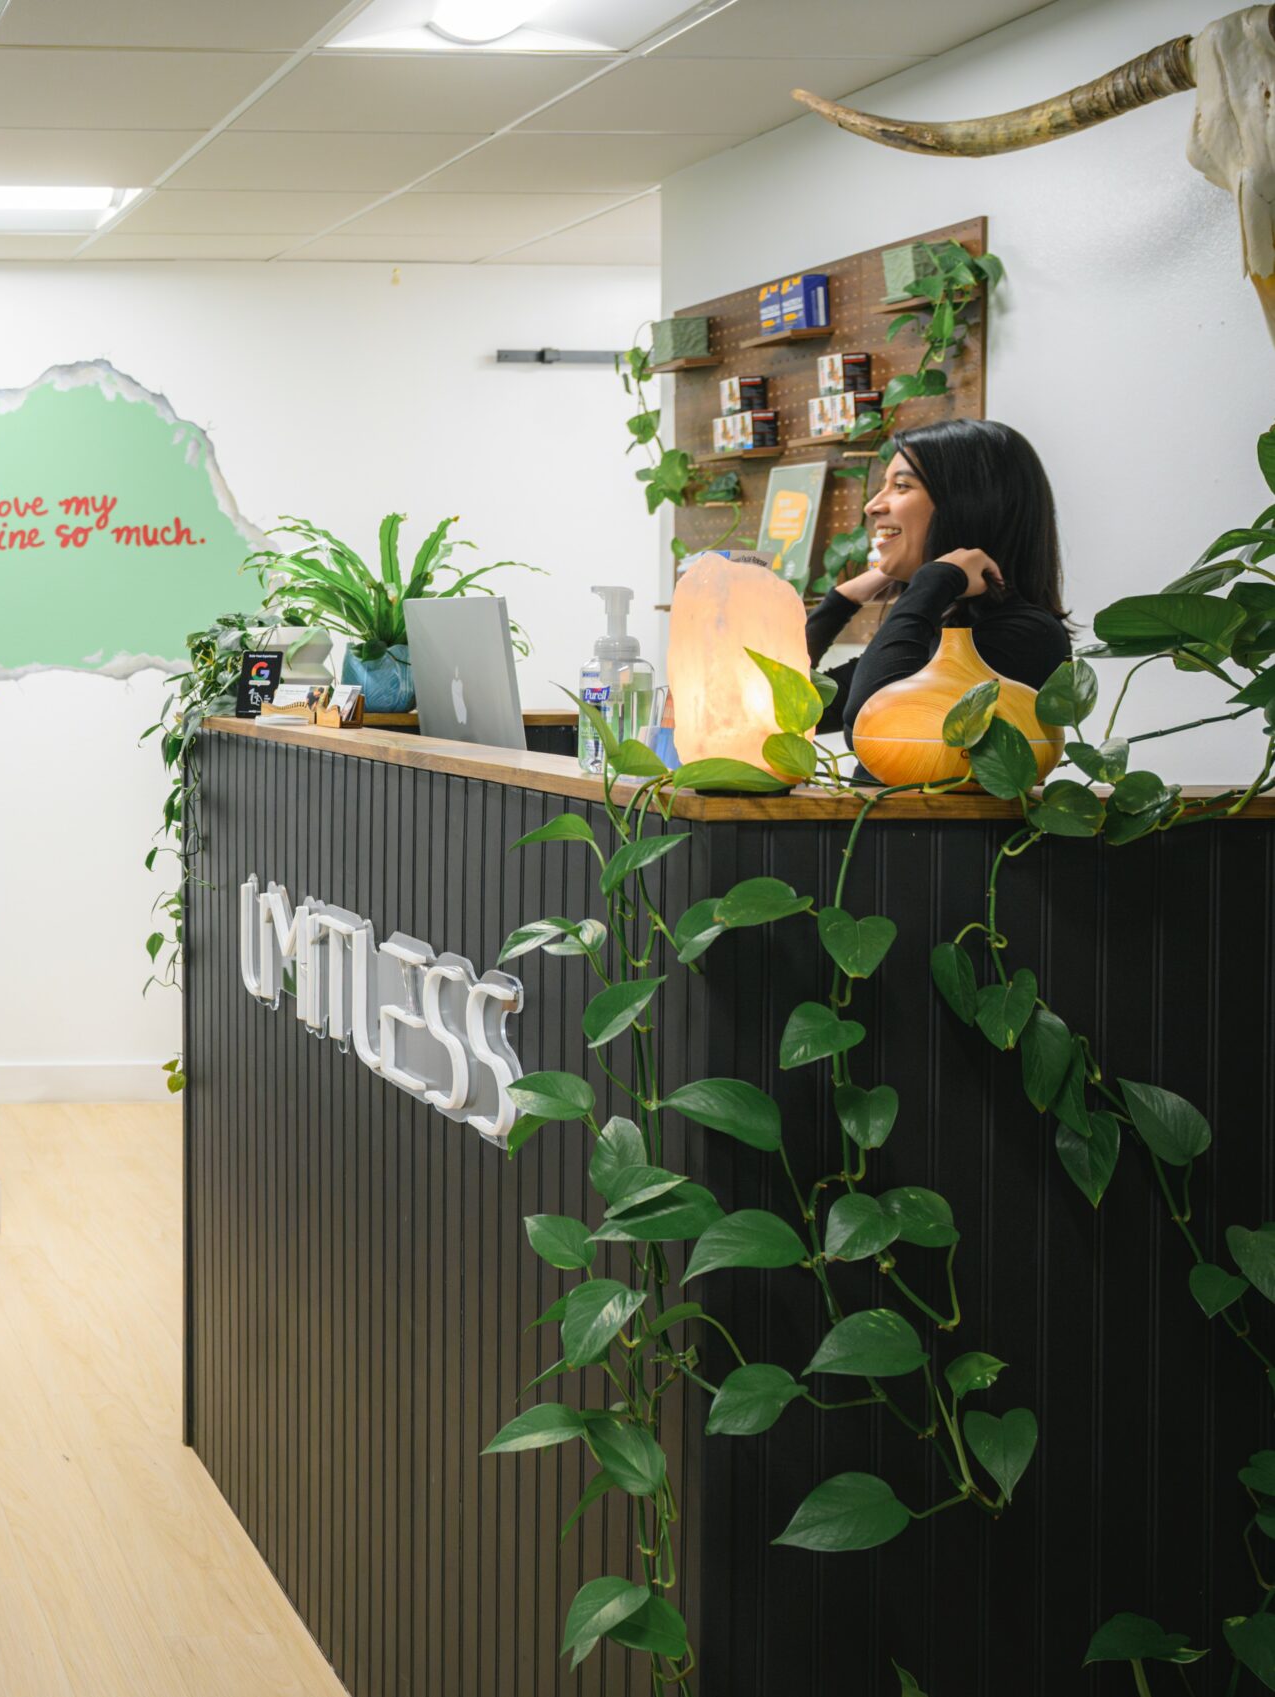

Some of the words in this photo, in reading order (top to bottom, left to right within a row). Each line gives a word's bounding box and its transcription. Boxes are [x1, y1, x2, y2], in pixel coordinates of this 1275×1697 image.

[58, 494, 118, 531] my
[55, 524, 93, 549] so
[111, 516, 207, 548] much.
